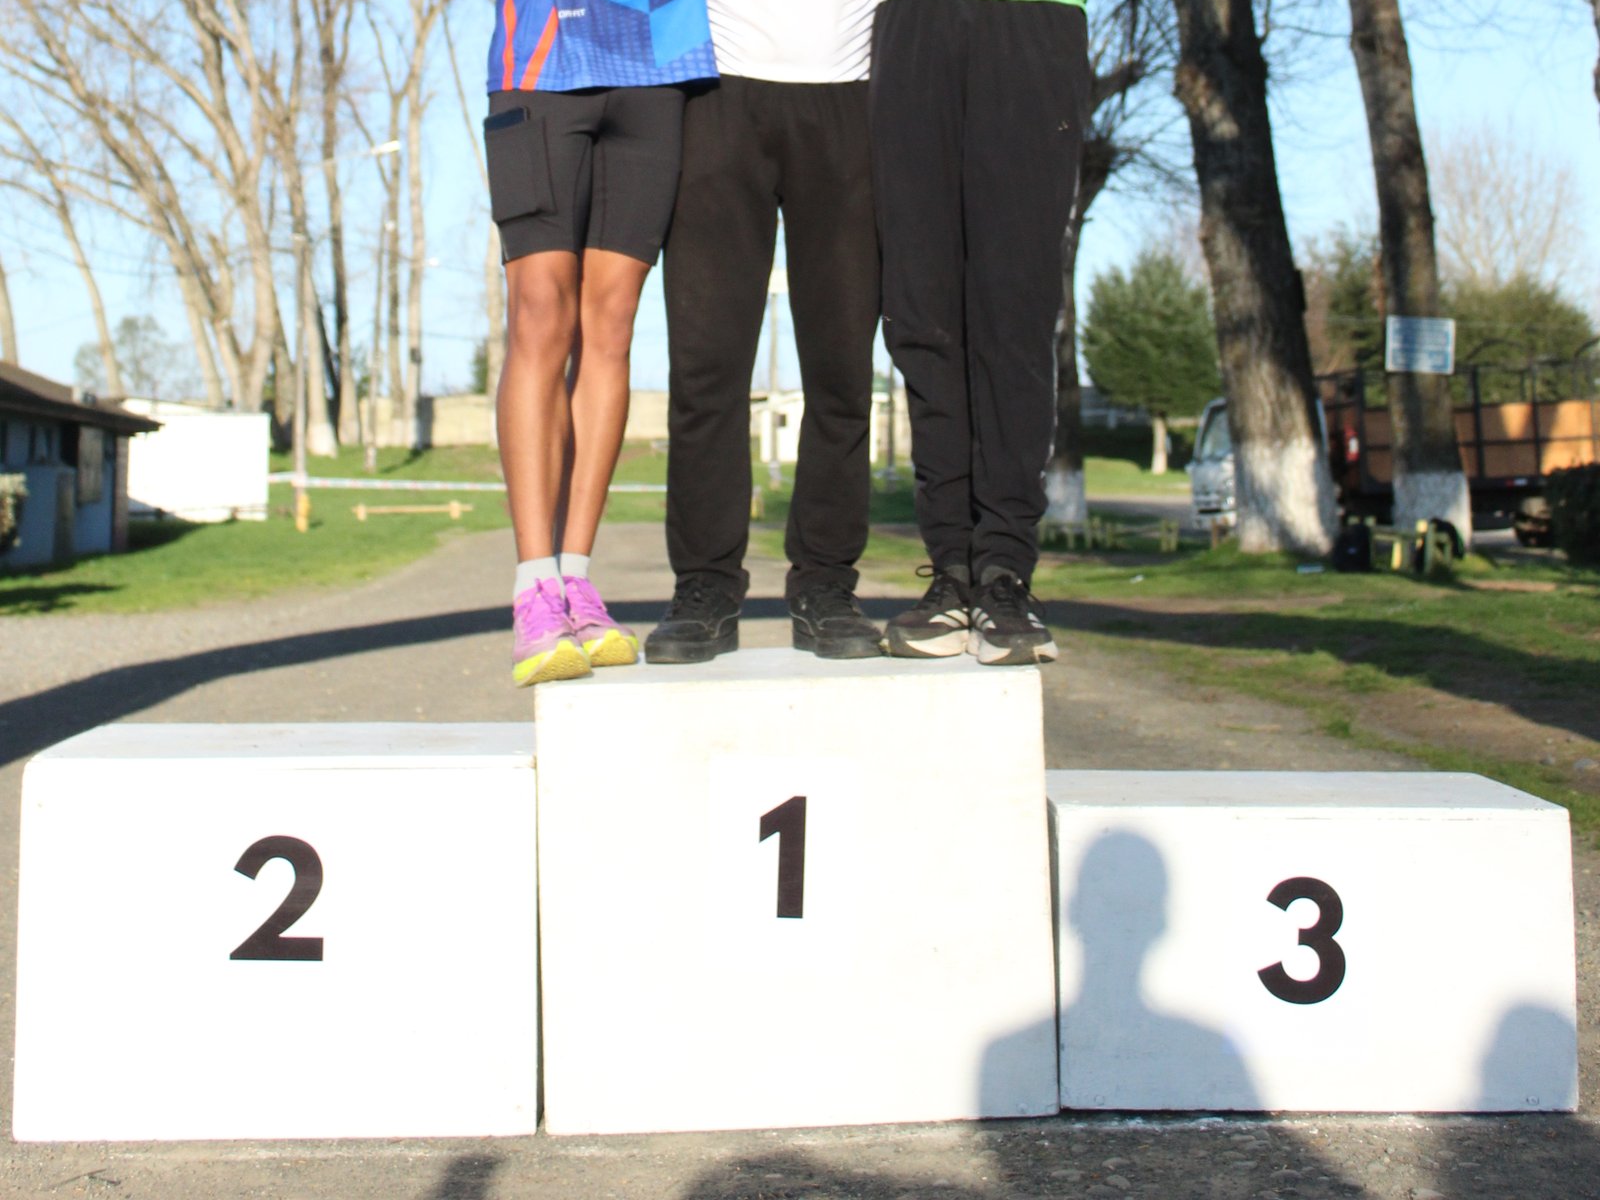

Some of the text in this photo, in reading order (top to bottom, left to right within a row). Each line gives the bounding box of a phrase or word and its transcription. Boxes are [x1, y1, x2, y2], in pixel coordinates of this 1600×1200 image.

[229, 835, 324, 962] 2
[759, 796, 807, 919] 1
[1257, 876, 1346, 1005] 3
